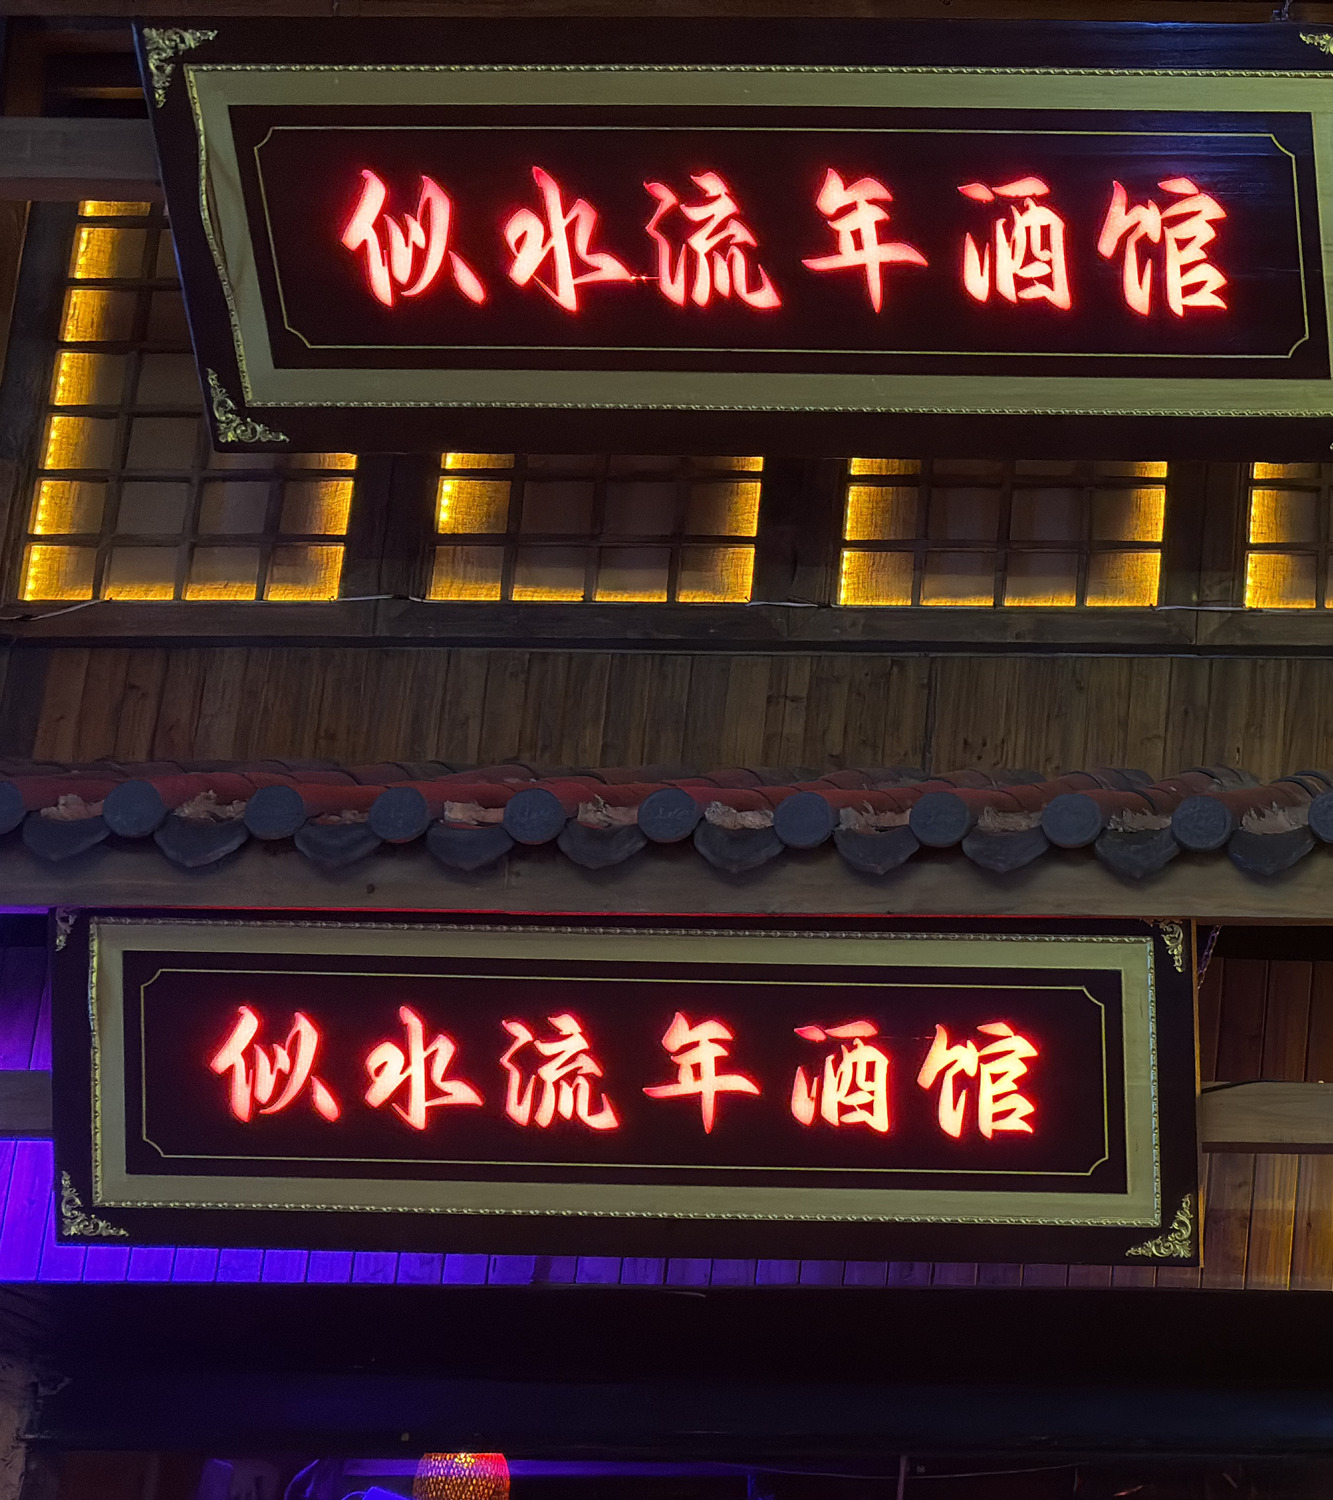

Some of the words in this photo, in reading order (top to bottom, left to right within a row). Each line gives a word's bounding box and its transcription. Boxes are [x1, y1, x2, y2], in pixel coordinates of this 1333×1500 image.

[342, 167, 1229, 317] 似水流年酒馆
[210, 1004, 1039, 1138] 似水流年酒馆
